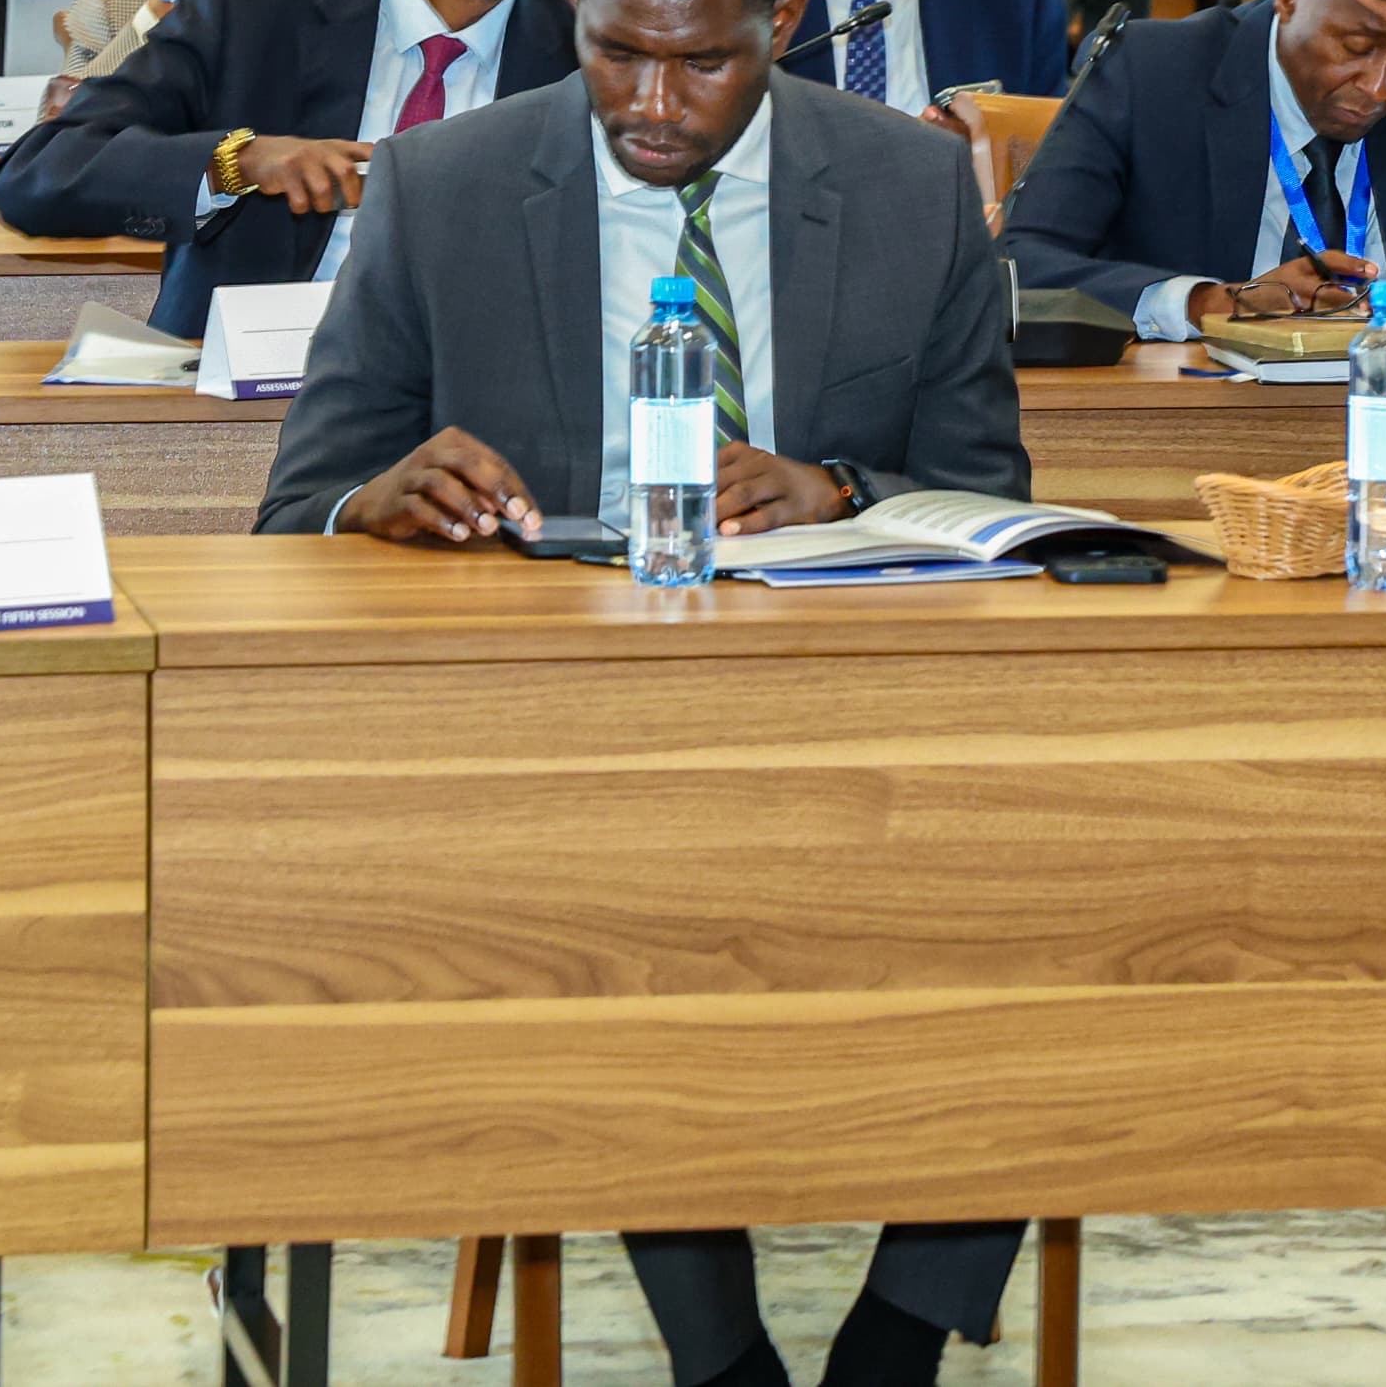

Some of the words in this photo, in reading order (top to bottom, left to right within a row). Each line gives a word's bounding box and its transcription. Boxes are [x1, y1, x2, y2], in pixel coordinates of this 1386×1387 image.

[255, 381, 302, 393] ASSESSMEN
[2, 610, 34, 624] FIFTH
[36, 606, 86, 621] SESSION
